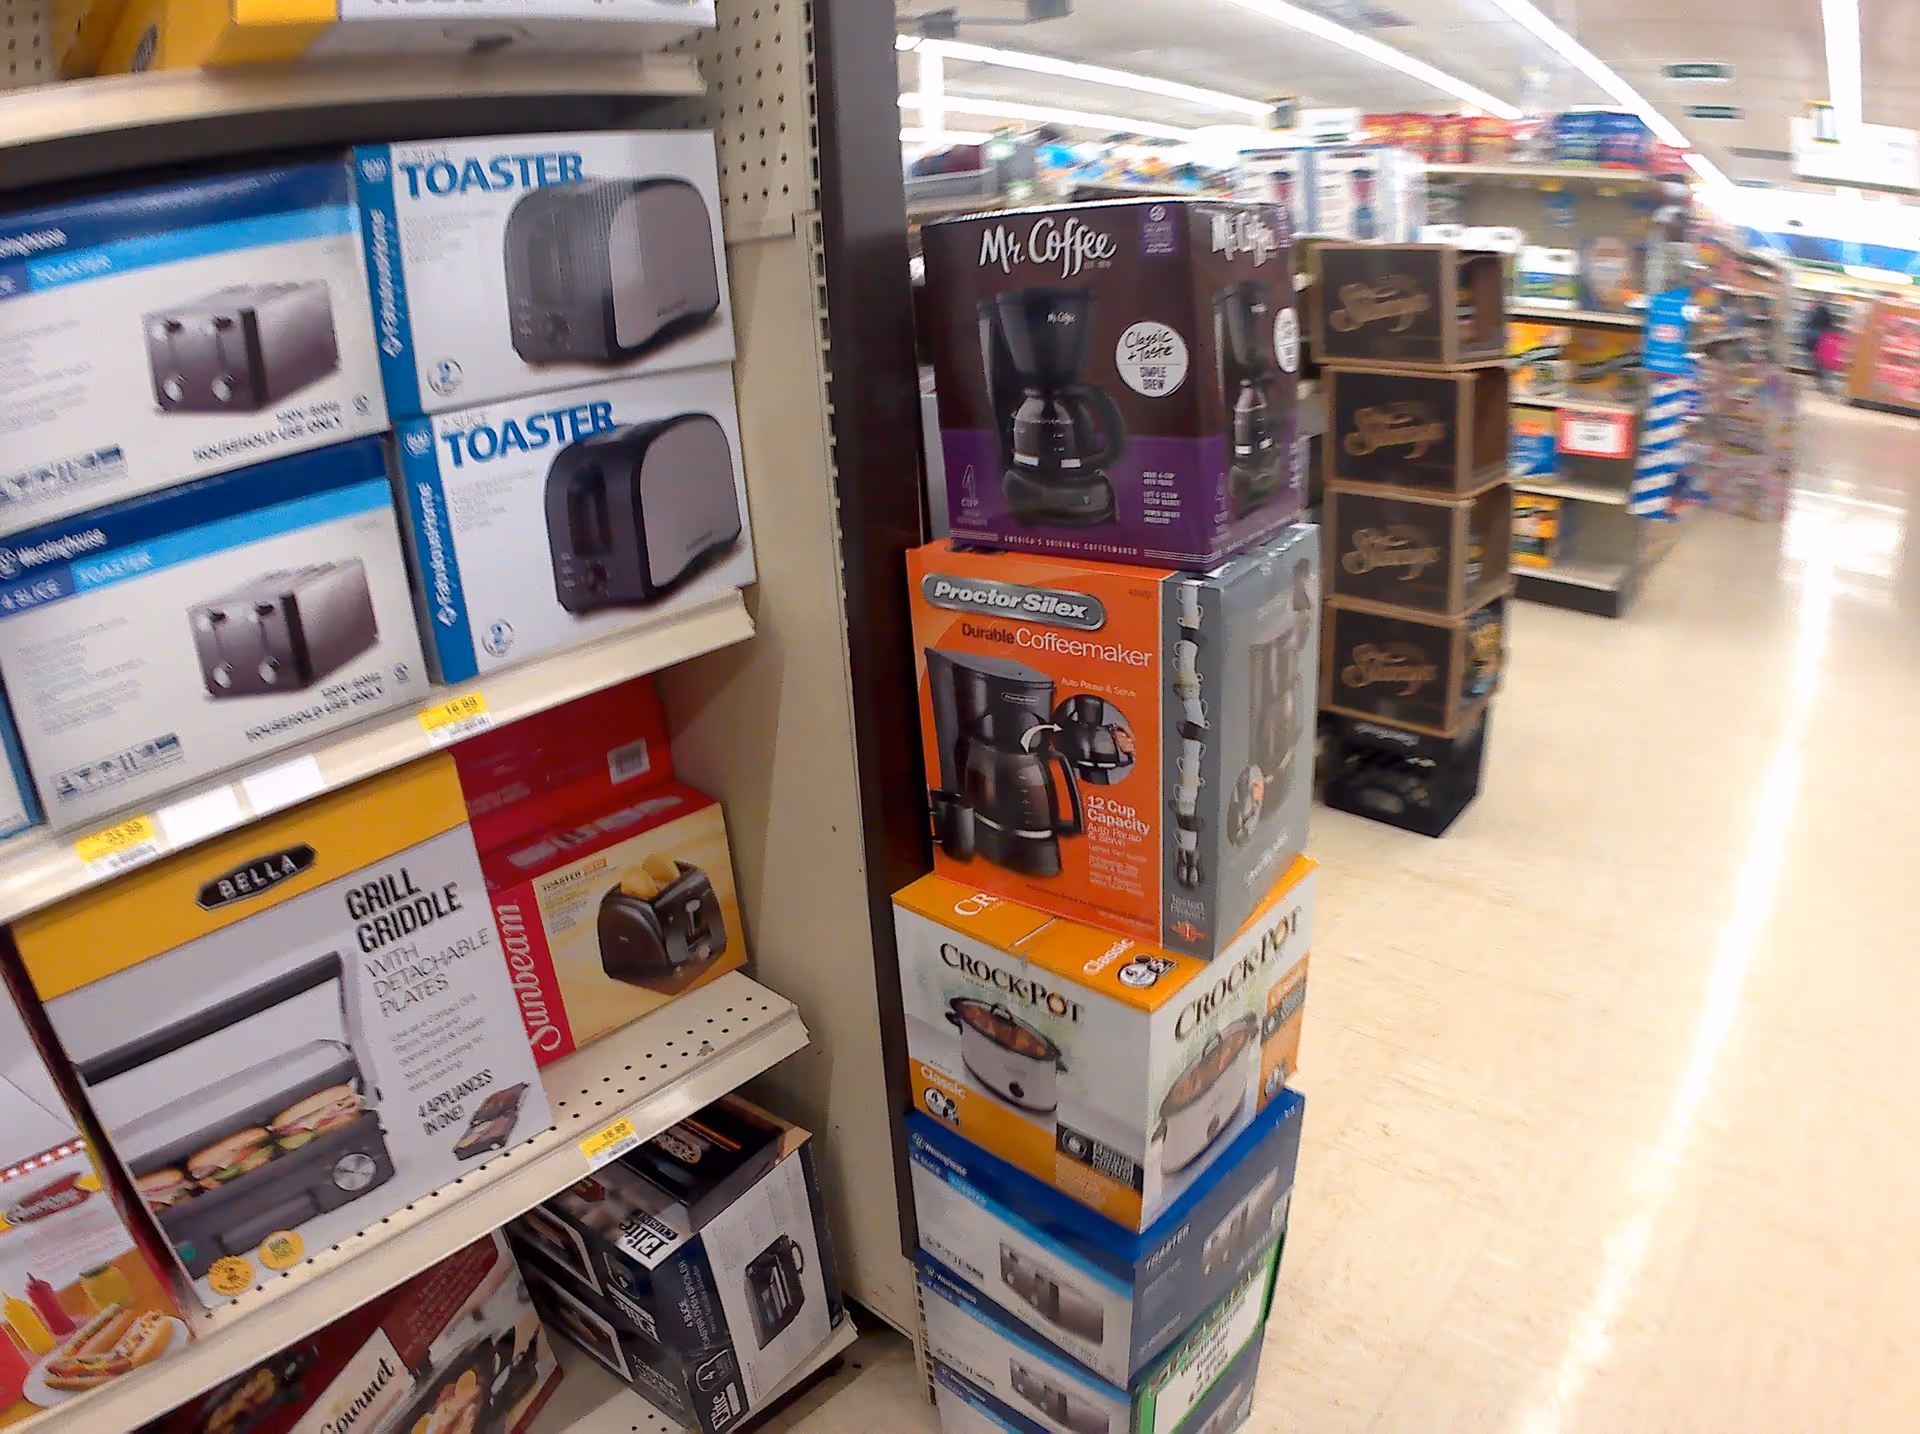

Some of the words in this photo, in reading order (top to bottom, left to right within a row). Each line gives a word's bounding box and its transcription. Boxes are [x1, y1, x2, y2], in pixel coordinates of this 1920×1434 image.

[400, 152, 584, 199] TOASTER
[978, 224, 1025, 274] Mr.
[1027, 216, 1118, 279] Coffee
[1125, 329, 1173, 348] Classic
[1140, 367, 1167, 378] SIMPLE
[1143, 379, 1165, 390] BREW
[441, 401, 616, 468] TOASTER
[17, 528, 108, 568] Westinghouse
[1084, 543, 1138, 556] COFFEEMAKER
[962, 623, 1015, 645] Durable
[1015, 627, 1153, 668] Coffeemaker
[1061, 677, 1078, 688] Auto
[1080, 680, 1103, 692] Pause
[1105, 684, 1113, 694] &
[1087, 795, 1105, 811] 12
[1107, 800, 1135, 820] Cup
[1087, 808, 1150, 837] Capacity
[217, 854, 299, 899] BELLA
[344, 866, 421, 920] GRILL
[541, 870, 581, 891] TOASTER
[356, 881, 464, 953] GRIDDLE
[364, 942, 420, 978] WITH
[373, 927, 490, 999] DETACHABLE
[1083, 938, 1135, 975] Classic
[380, 973, 450, 1018] PLATES
[496, 903, 562, 1052] Sunbeam
[426, 1068, 494, 1113] APPLIANCES
[921, 1065, 967, 1100] Classic
[619, 1219, 669, 1260] Elite
[320, 1357, 396, 1434] Gourmet
[711, 1391, 731, 1432] Elite
